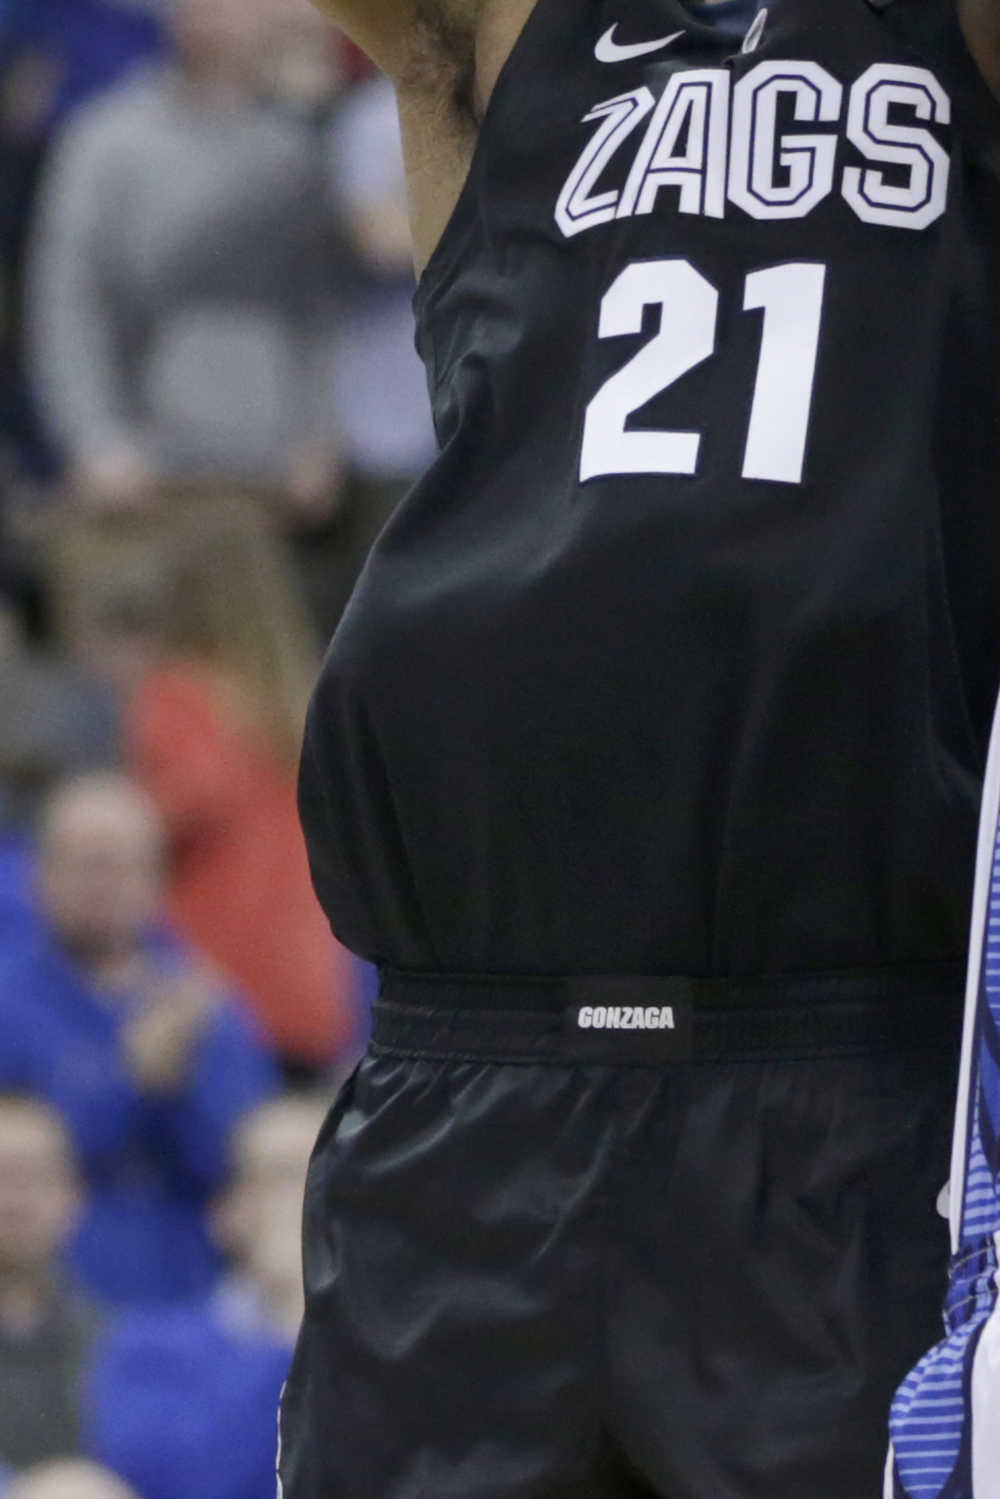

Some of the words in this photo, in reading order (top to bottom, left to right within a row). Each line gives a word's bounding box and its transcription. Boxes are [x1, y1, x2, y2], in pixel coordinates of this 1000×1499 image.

[554, 60, 951, 238] ZAGS
[579, 259, 826, 484] 21
[577, 1006, 675, 1029] GONZAGA
